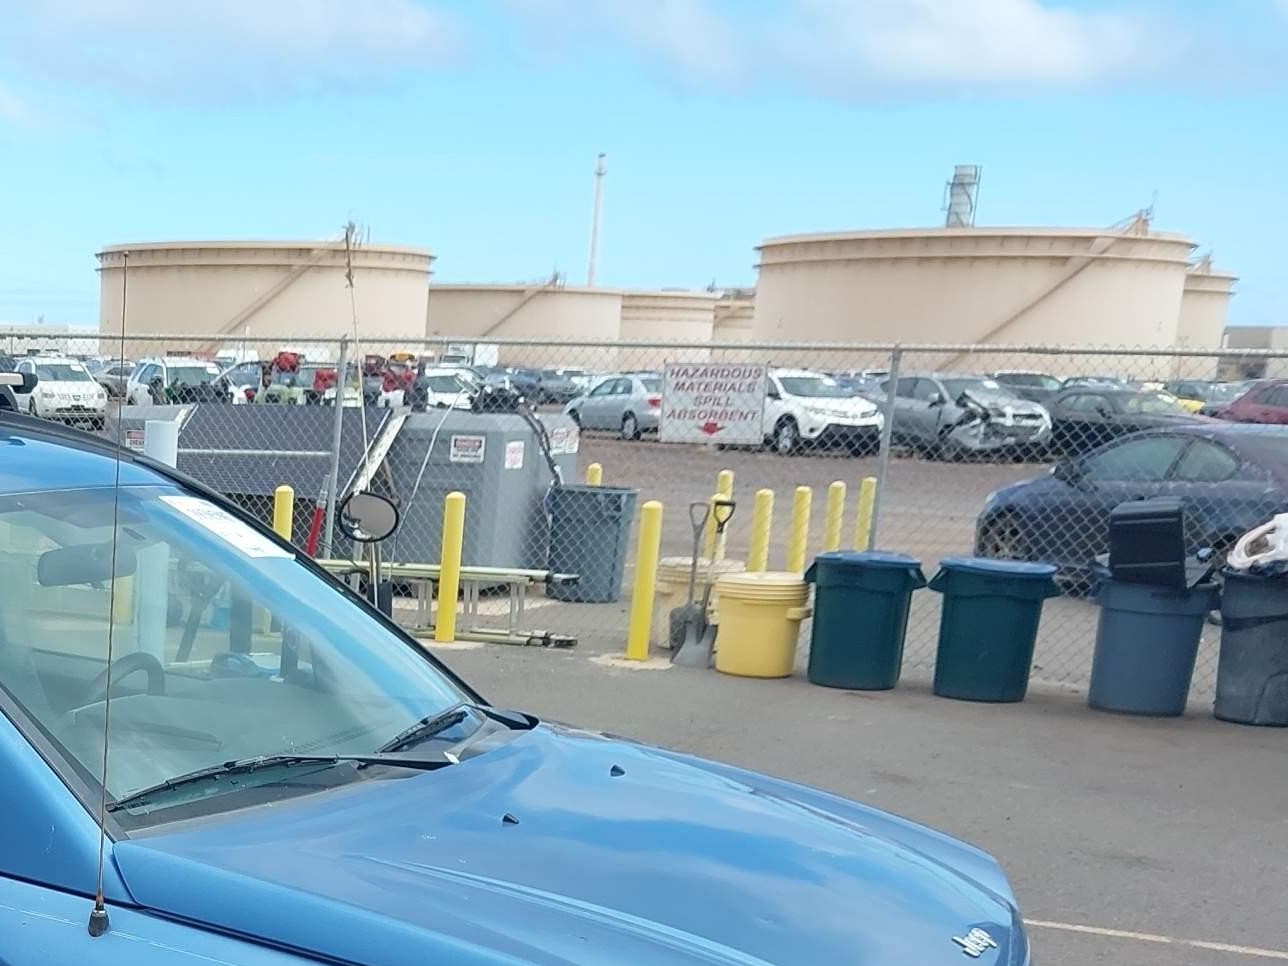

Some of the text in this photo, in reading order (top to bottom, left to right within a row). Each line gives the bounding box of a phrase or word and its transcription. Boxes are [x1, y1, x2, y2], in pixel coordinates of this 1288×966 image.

[670, 367, 762, 380] HAZARDOUS
[673, 381, 758, 393] MATERIALS
[693, 394, 733, 407] SPILL
[666, 408, 758, 421] ABSORBENT
[952, 927, 998, 957] Jeep
